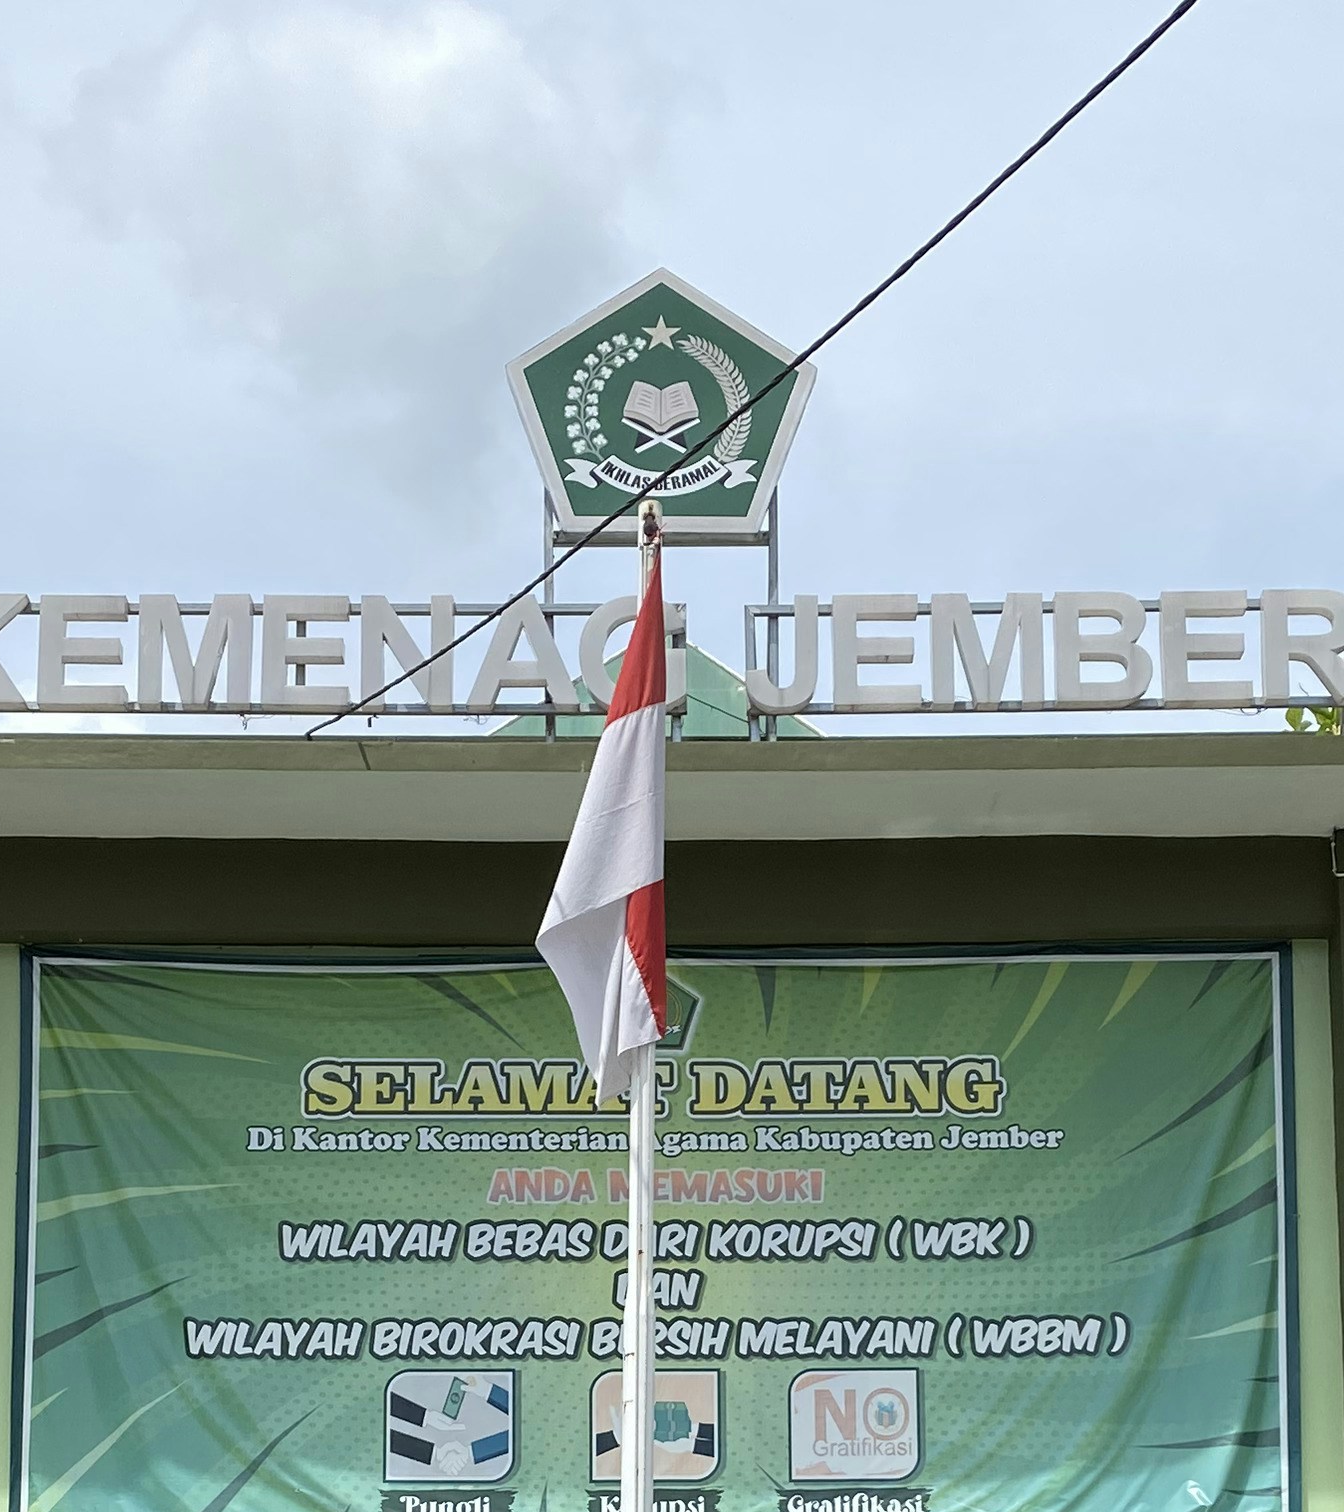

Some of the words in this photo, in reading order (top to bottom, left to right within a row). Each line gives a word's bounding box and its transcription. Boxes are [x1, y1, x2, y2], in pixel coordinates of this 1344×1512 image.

[601, 460, 651, 490] IKHLAS
[654, 460, 721, 491] BERAMAL
[692, 1059, 1005, 1115] DATANG
[247, 1126, 285, 1151] Di
[291, 1126, 411, 1152] Kantor
[415, 1126, 629, 1152] Kementerian
[654, 1131, 748, 1156] gama
[754, 1127, 935, 1155] Kabupaten
[940, 1125, 1064, 1150] Jember
[486, 1169, 596, 1203] ANDA
[280, 1222, 458, 1259] WILAYAH
[466, 1221, 595, 1259] BEBAS
[602, 1221, 699, 1258] DRI
[708, 1219, 876, 1259] KORUPSI
[185, 1318, 364, 1357] WILAYAH
[372, 1318, 582, 1357] BIROKRASI
[739, 1318, 935, 1356] MELAYANI
[811, 1437, 914, 1459] Gratifikasi
